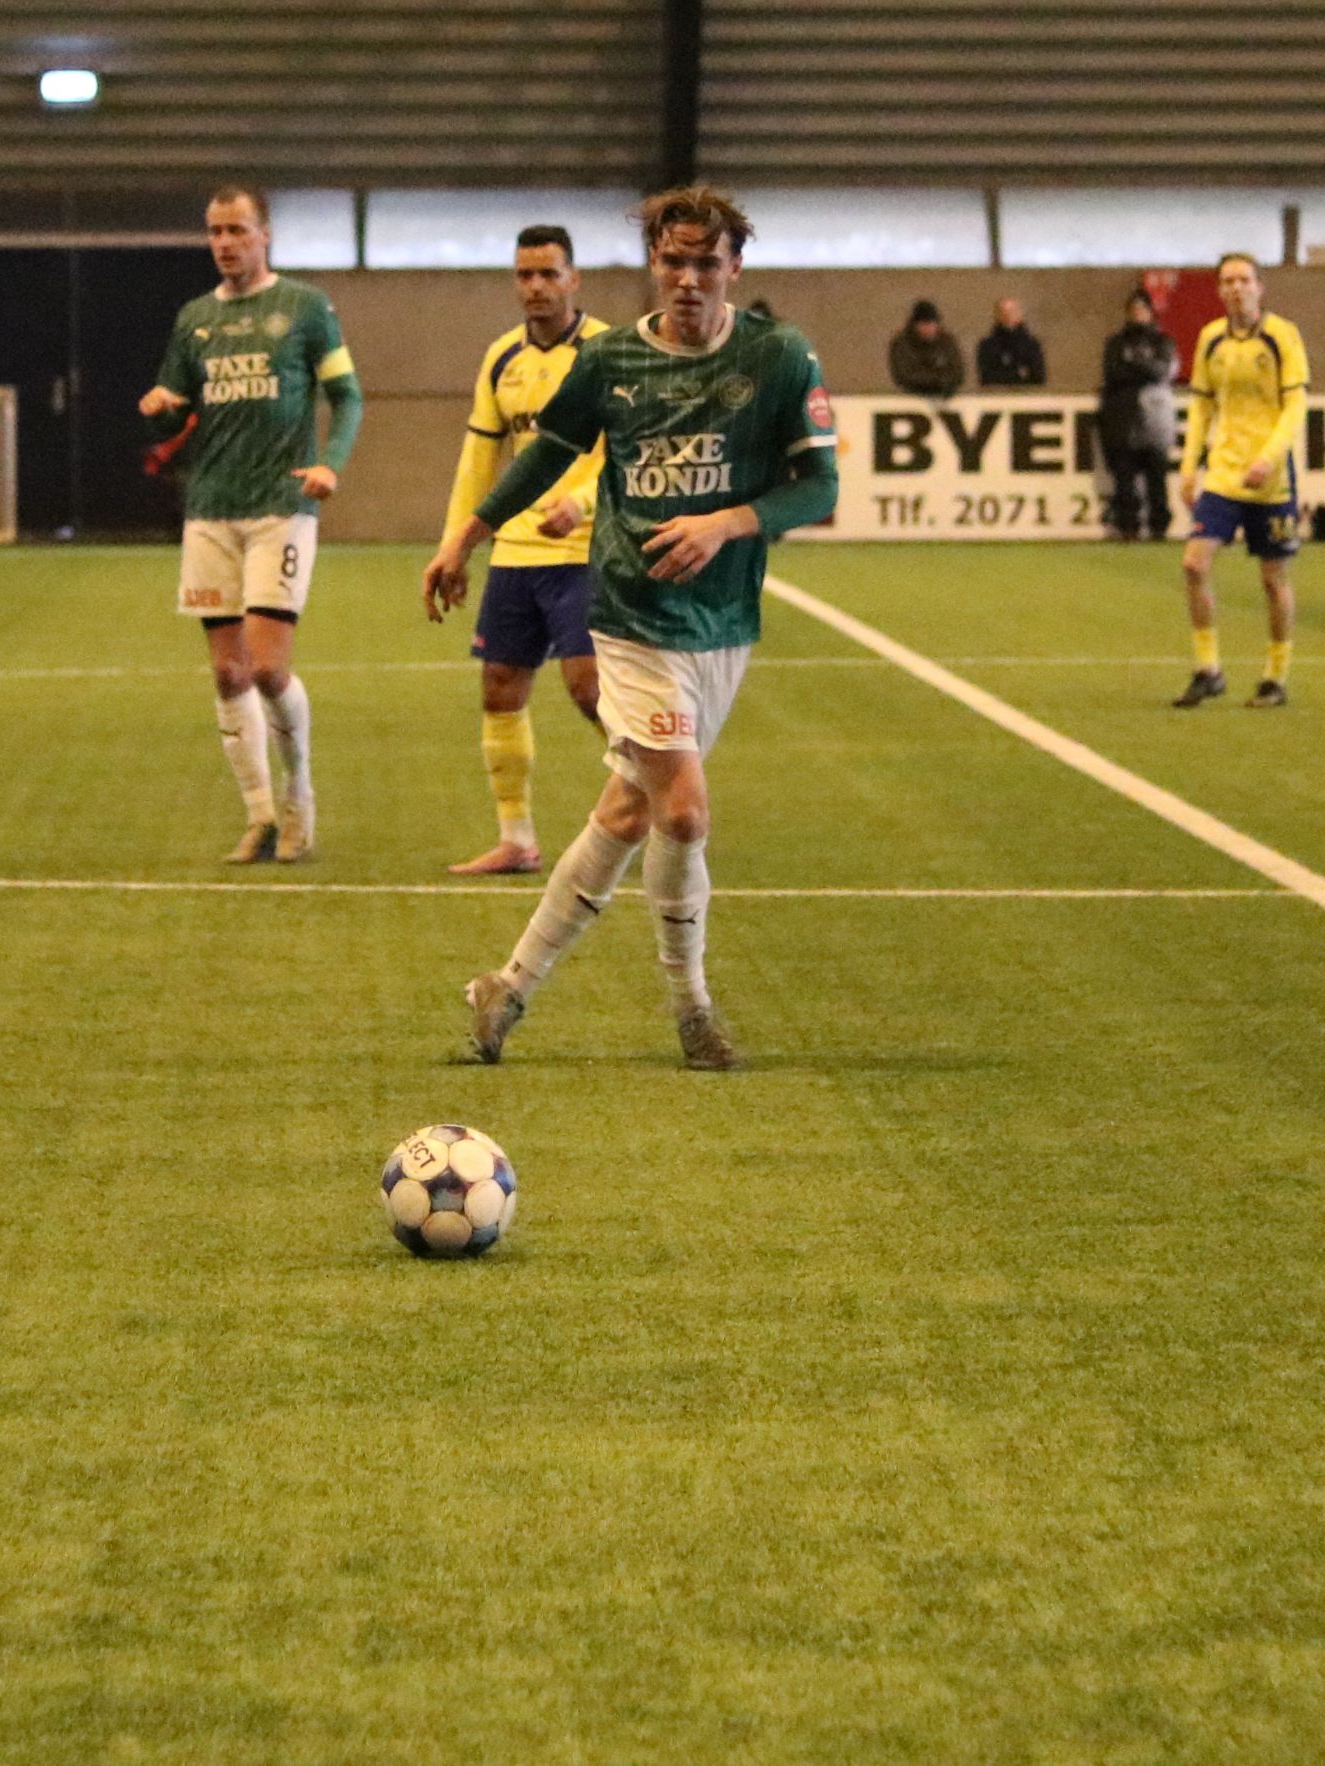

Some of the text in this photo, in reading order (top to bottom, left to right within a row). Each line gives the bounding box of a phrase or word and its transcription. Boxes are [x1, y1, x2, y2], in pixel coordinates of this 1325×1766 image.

[205, 352, 270, 380] FAXE
[203, 375, 280, 405] KONDI
[635, 433, 725, 466] FAXE
[625, 463, 731, 498] KONDI
[872, 495, 936, 526] Tlf.
[954, 495, 1050, 526] 2071
[281, 543, 298, 578] 8
